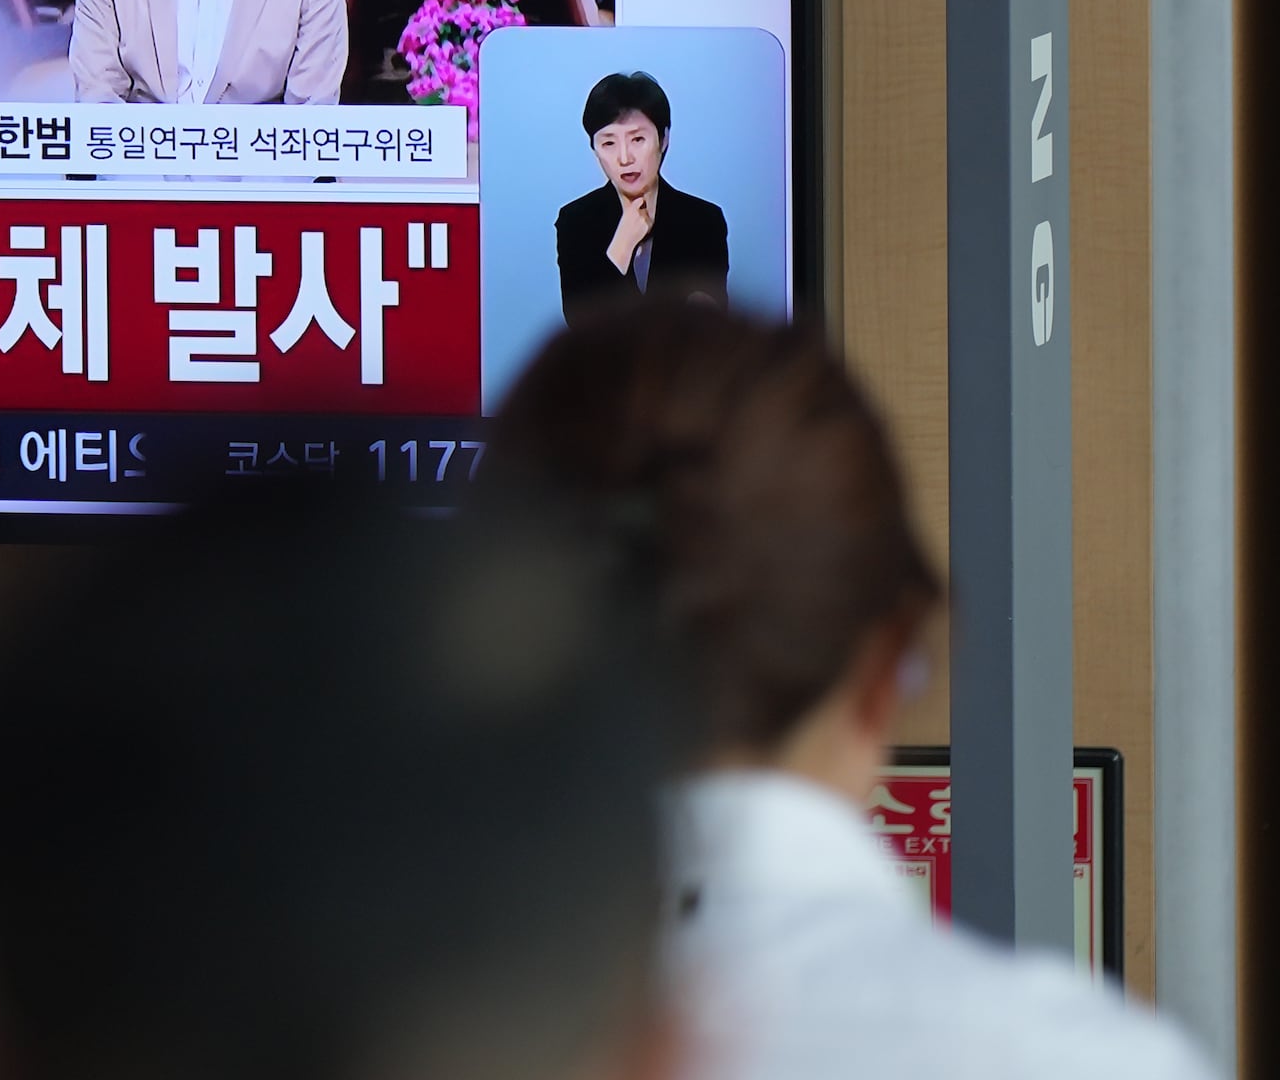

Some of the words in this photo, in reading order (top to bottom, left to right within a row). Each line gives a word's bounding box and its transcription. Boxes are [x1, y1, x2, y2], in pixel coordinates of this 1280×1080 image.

[85, 125, 239, 162] 통일연구원
[250, 127, 434, 163] 석좌연구위원
[153, 222, 449, 386] 발사"
